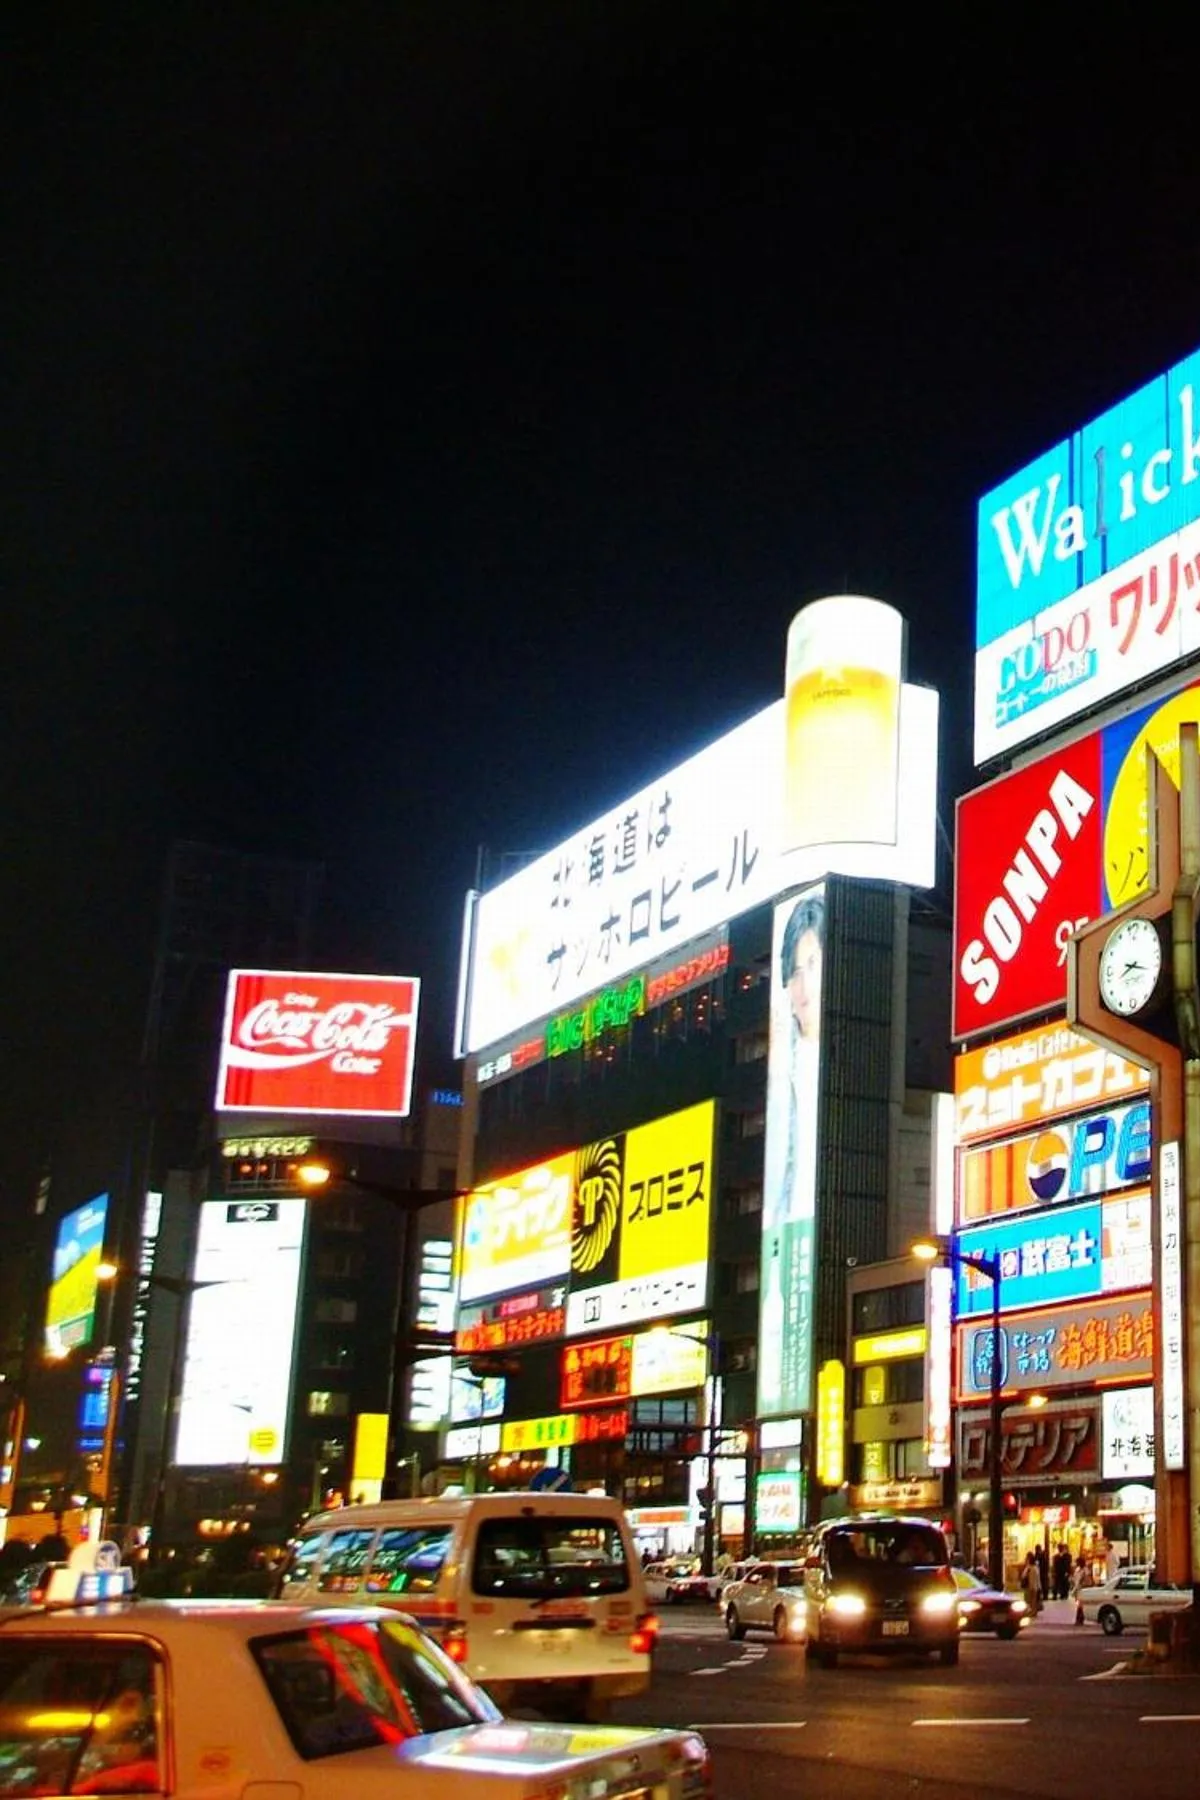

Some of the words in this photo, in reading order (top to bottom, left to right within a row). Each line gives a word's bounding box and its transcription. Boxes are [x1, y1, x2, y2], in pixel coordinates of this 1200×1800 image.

[550, 789, 673, 909] 北海道は
[960, 769, 1096, 1005] SONPA
[238, 999, 396, 1051] Coca-Cola
[628, 1162, 705, 1224] プロミス
